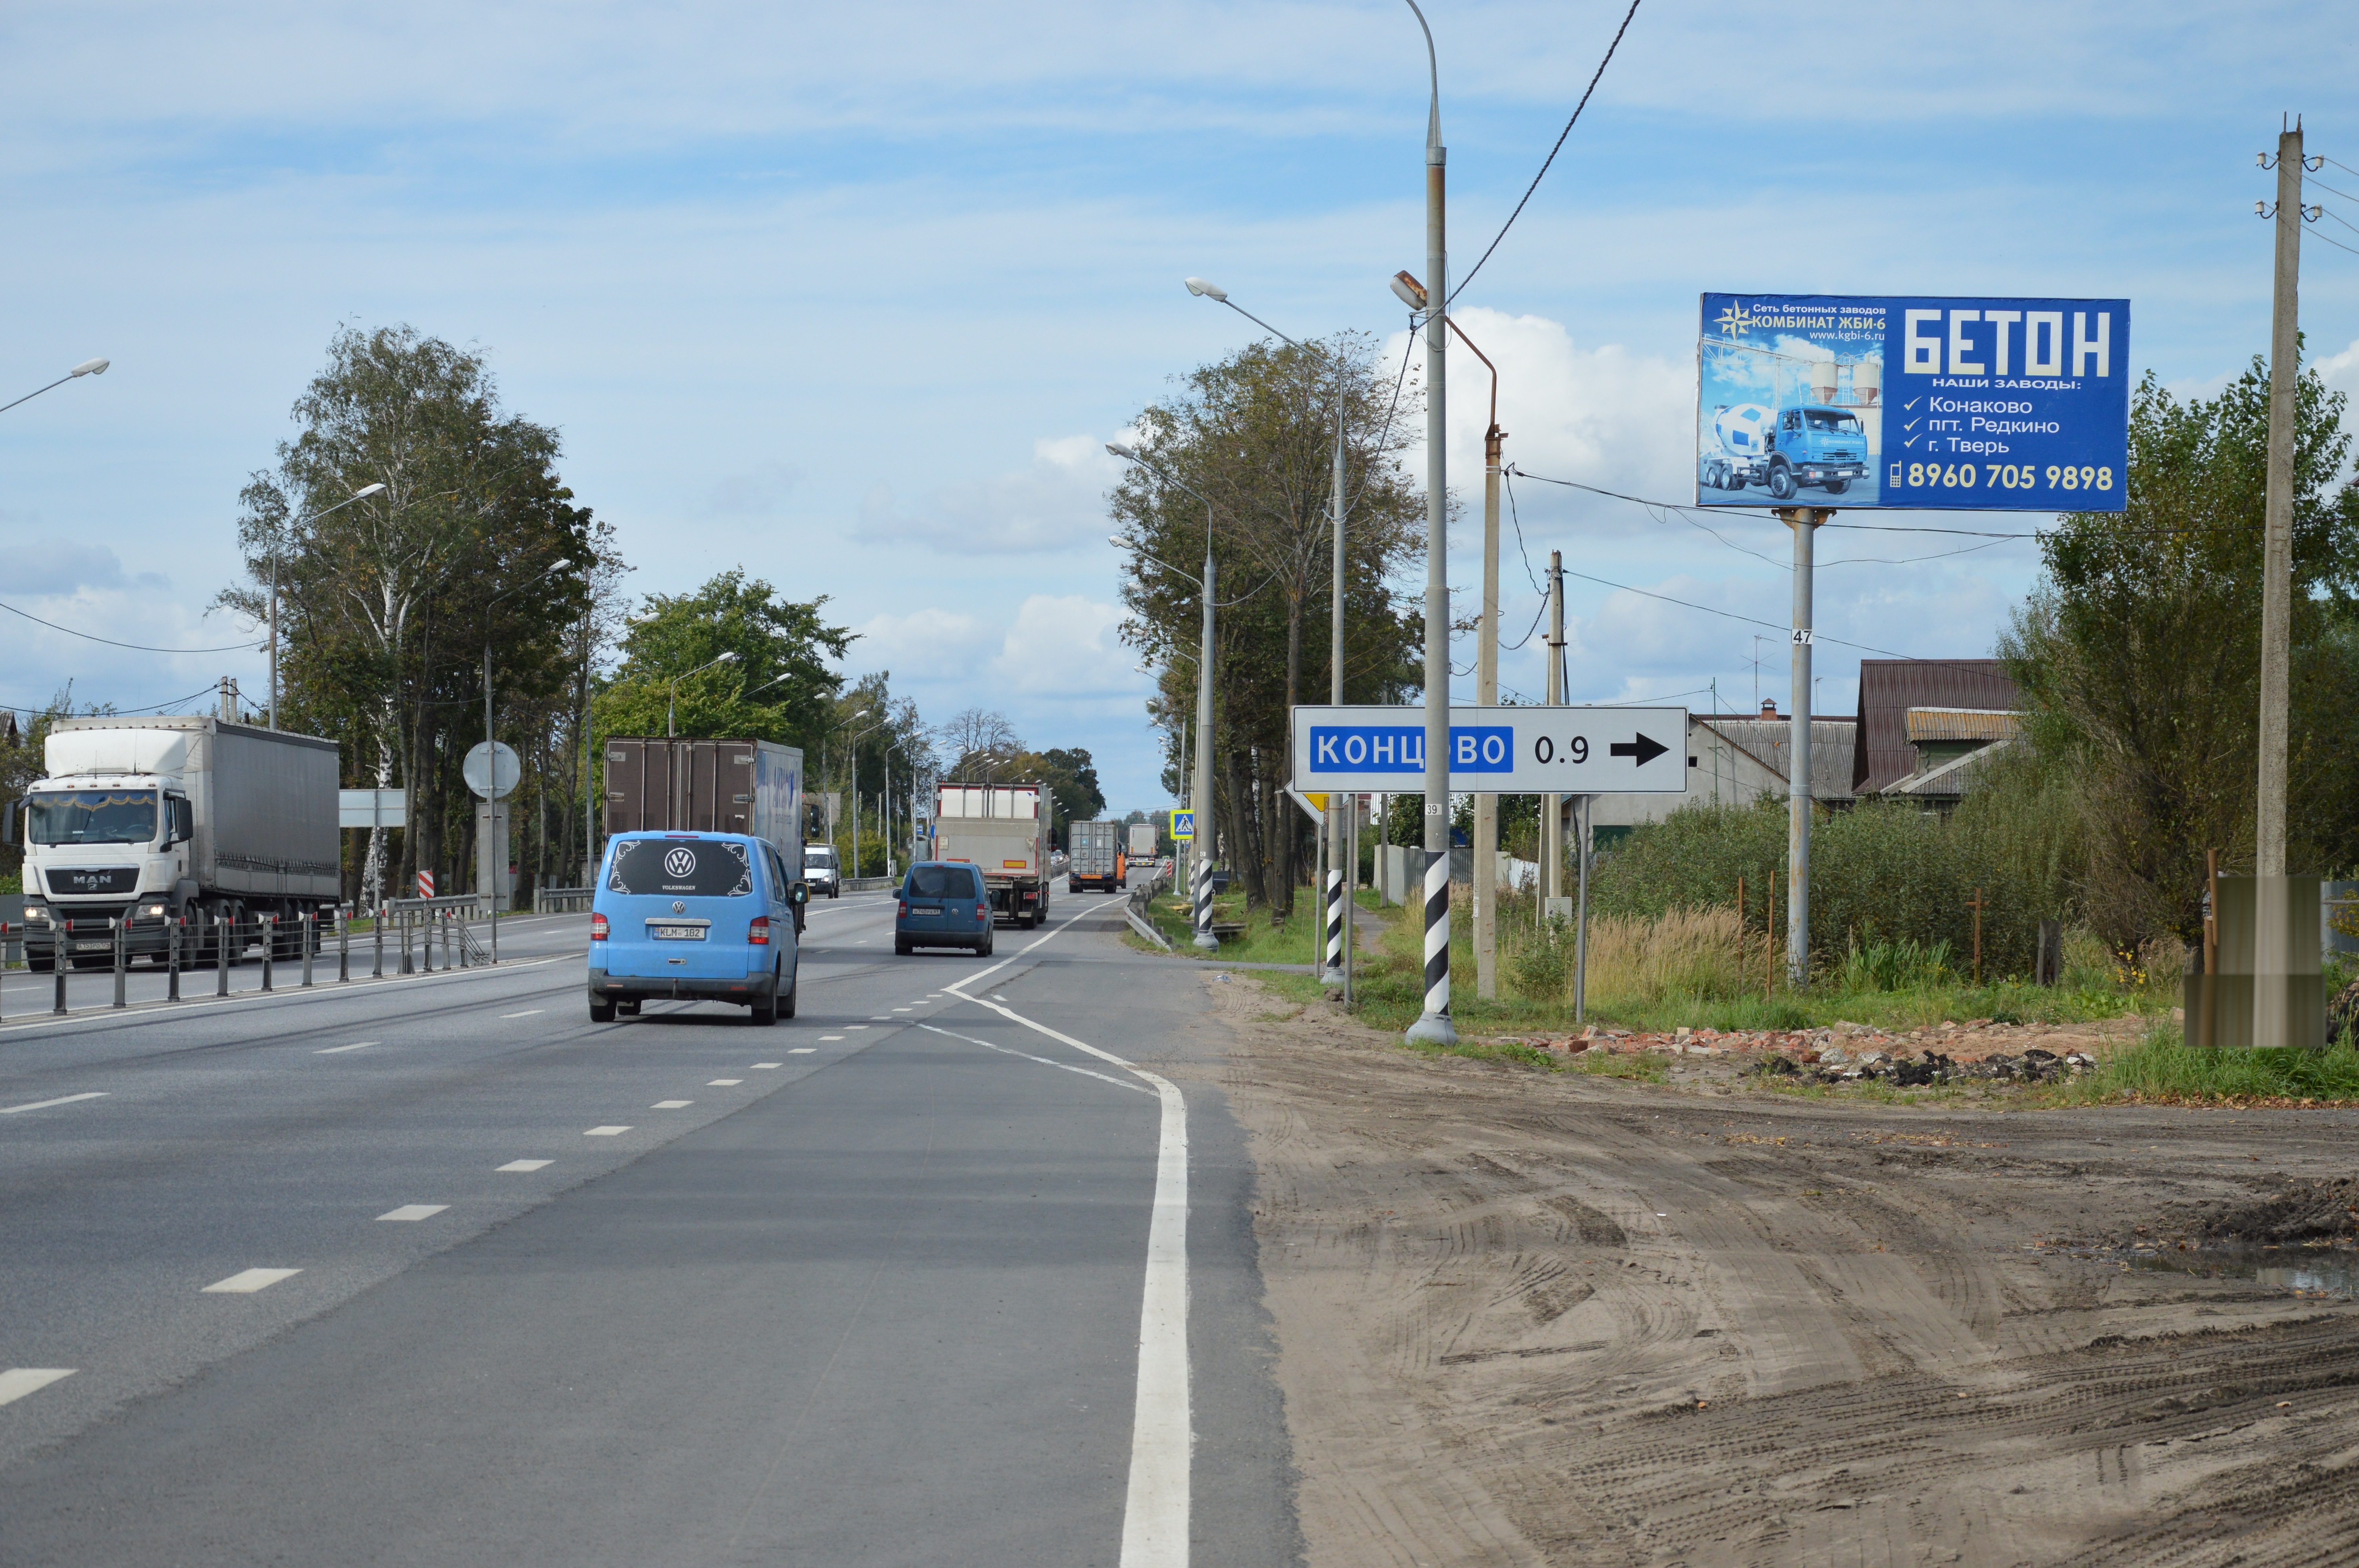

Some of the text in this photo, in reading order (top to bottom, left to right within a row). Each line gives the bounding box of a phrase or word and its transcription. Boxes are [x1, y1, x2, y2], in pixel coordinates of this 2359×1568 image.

[1753, 304, 1886, 315] Сеть бетонных заводов
[1752, 315, 1886, 330] КОМБИНАТ ЖБИ-6
[1810, 330, 1885, 341] www.kgbi-6.ru
[1904, 309, 2110, 377] БЕТОН
[1933, 378, 2081, 390] НАШИ ЗАВОДЫ:
[1930, 397, 2032, 414] Конаково
[1929, 417, 2060, 435] пгт. Редкино
[1928, 437, 2010, 456] г. Тверь
[1908, 463, 2113, 490] 8960 705 9898
[1793, 630, 1812, 643] 47
[1318, 735, 1589, 769] КОНЦВО 0.9
[1427, 805, 1437, 814] 39
[73, 875, 111, 884] MAN
[660, 928, 700, 937] KLM 102
